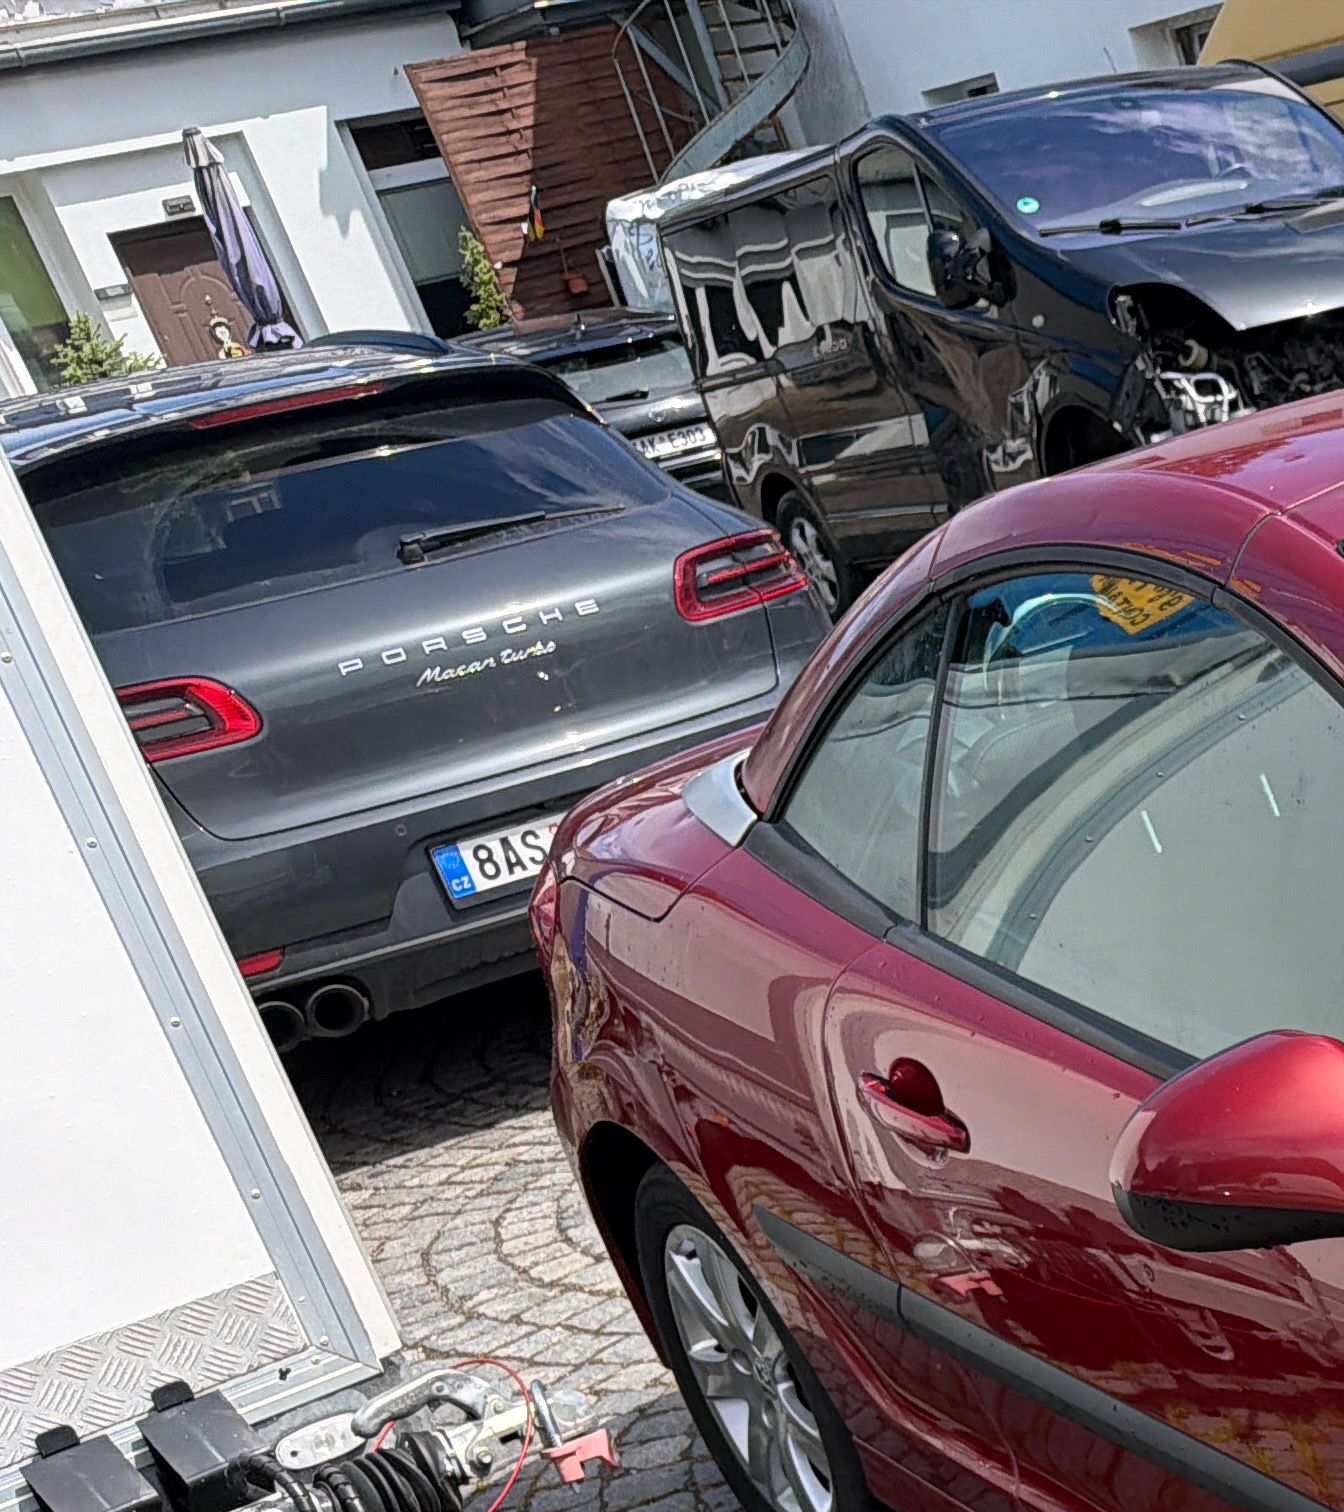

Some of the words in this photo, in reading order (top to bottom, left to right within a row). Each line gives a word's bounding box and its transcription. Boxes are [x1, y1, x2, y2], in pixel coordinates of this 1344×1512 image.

[338, 599, 600, 677] PORSCHE
[416, 656, 497, 688] Macan
[472, 829, 549, 880] 8AS
[451, 875, 472, 892] CZ
